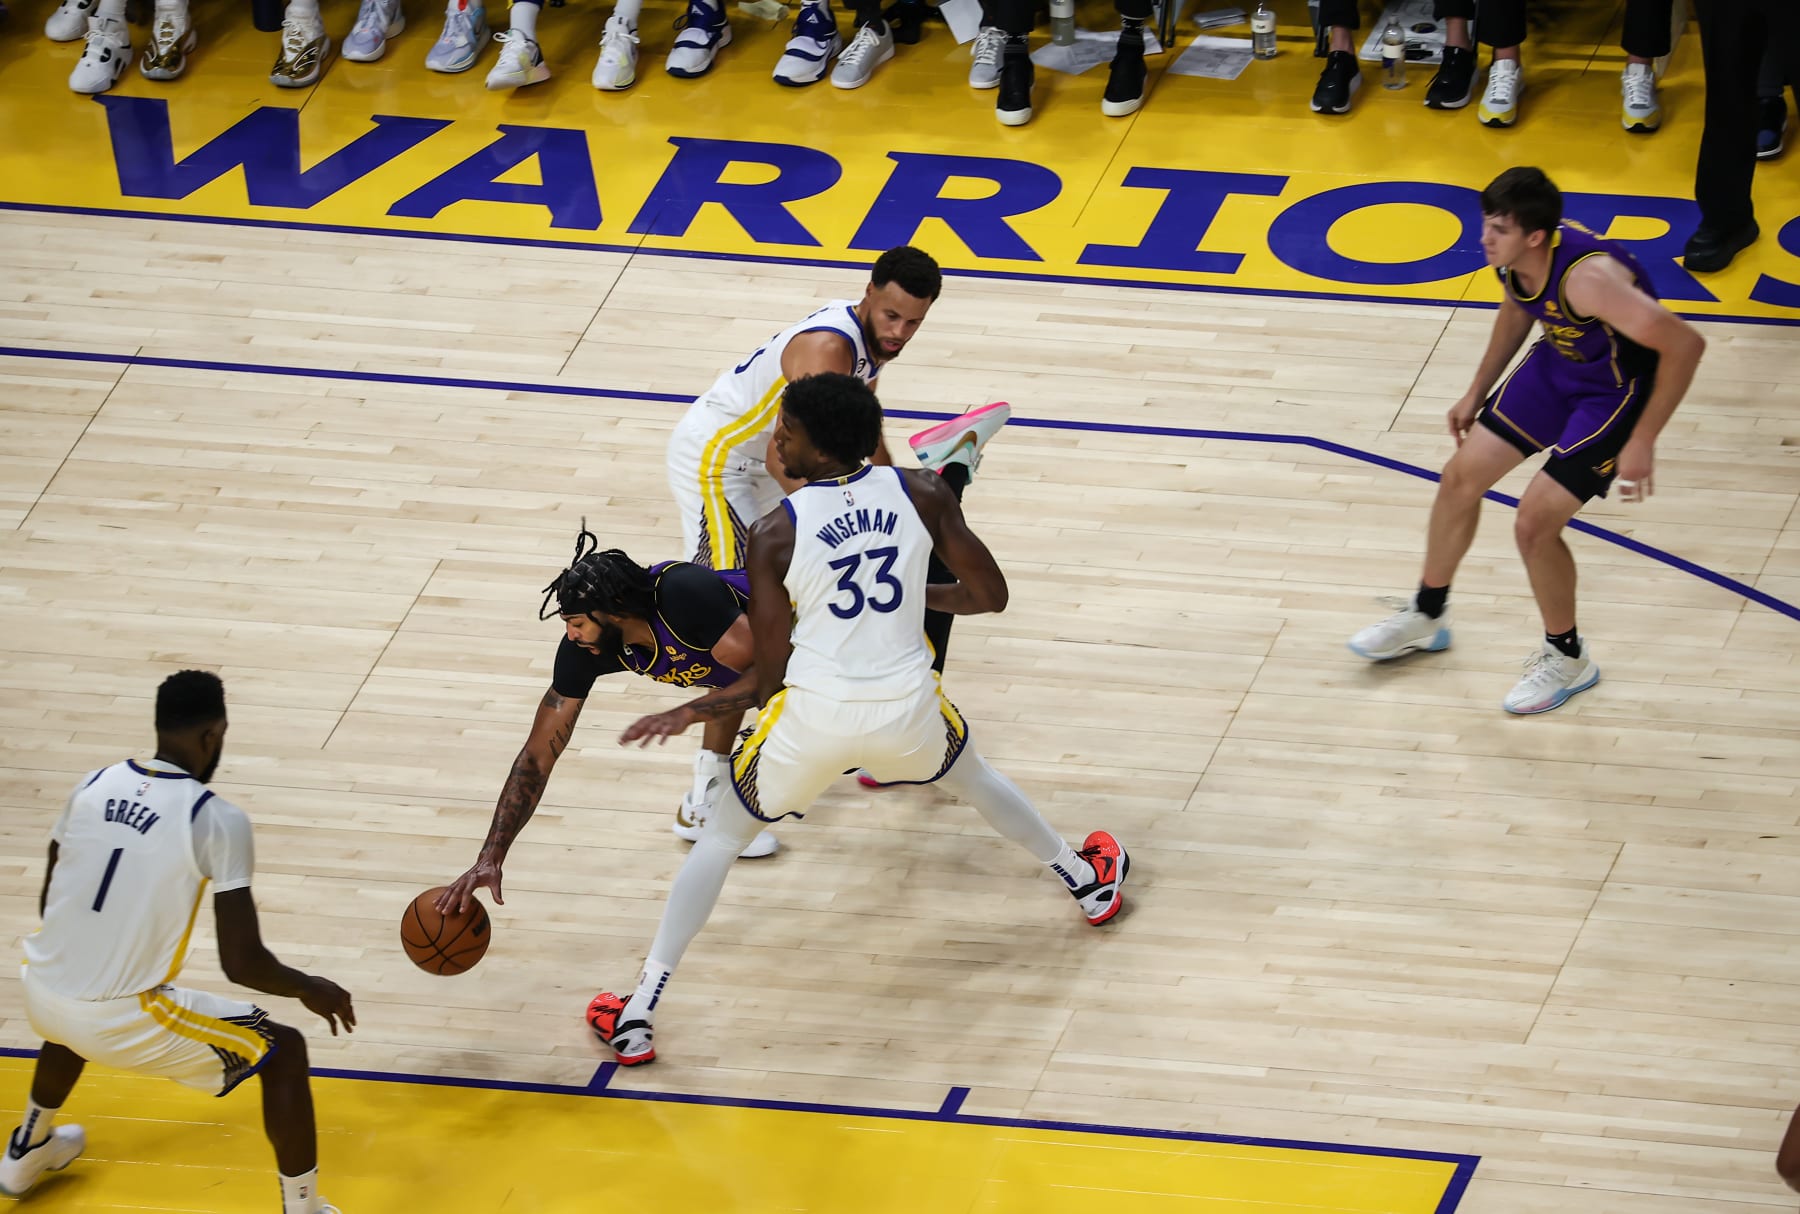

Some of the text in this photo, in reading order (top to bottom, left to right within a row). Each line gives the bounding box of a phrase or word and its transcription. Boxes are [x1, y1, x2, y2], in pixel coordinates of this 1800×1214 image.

[91, 94, 1800, 308] WARRIOR
[816, 508, 898, 549] WISEMAN
[828, 546, 903, 619] 33
[104, 798, 160, 835] GREEN
[91, 848, 124, 912] 1
